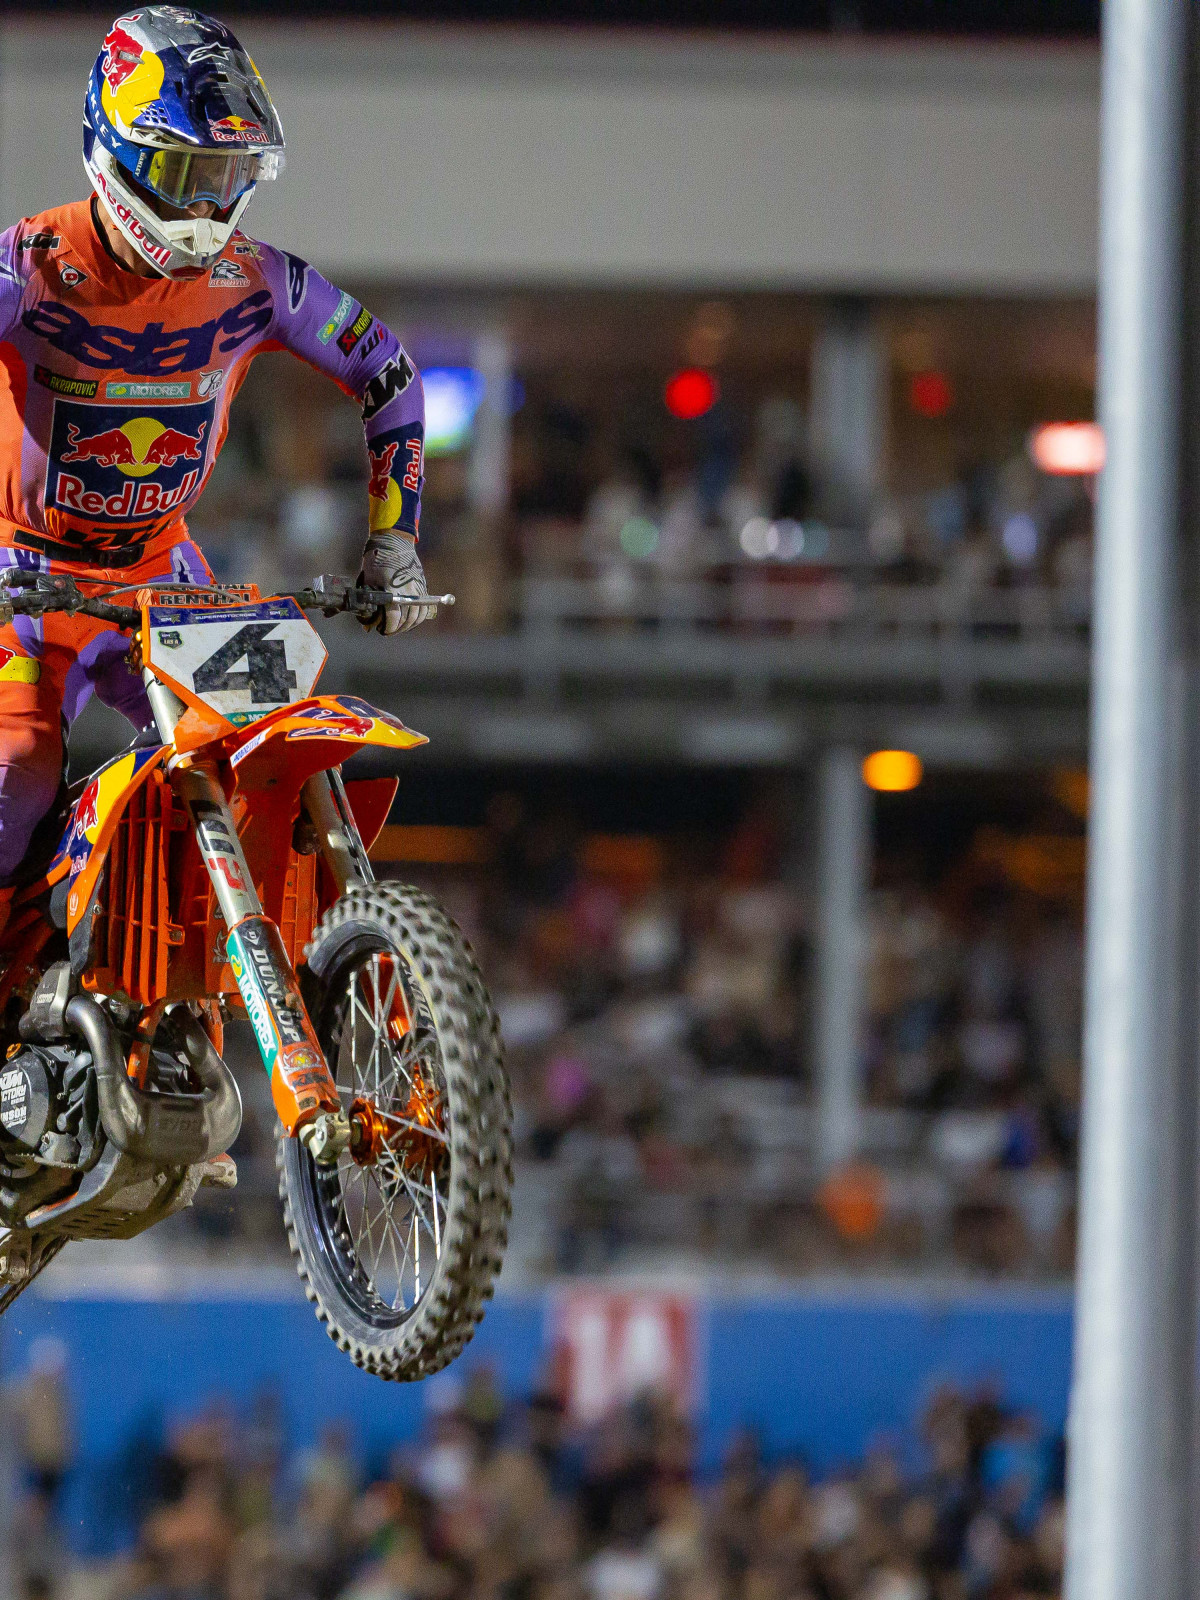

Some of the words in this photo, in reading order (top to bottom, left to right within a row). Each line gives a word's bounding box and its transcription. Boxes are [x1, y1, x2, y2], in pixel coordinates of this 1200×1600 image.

[212, 130, 243, 141] Red
[242, 130, 270, 143] Bull
[97, 172, 133, 223] Red
[128, 219, 173, 268] Bull
[129, 384, 185, 396] MOTOREX
[56, 471, 135, 517] Red
[132, 467, 199, 517] Bull
[192, 622, 298, 704] 4
[237, 973, 277, 1058] MOTOREX
[0, 1084, 27, 1102] CTORY
